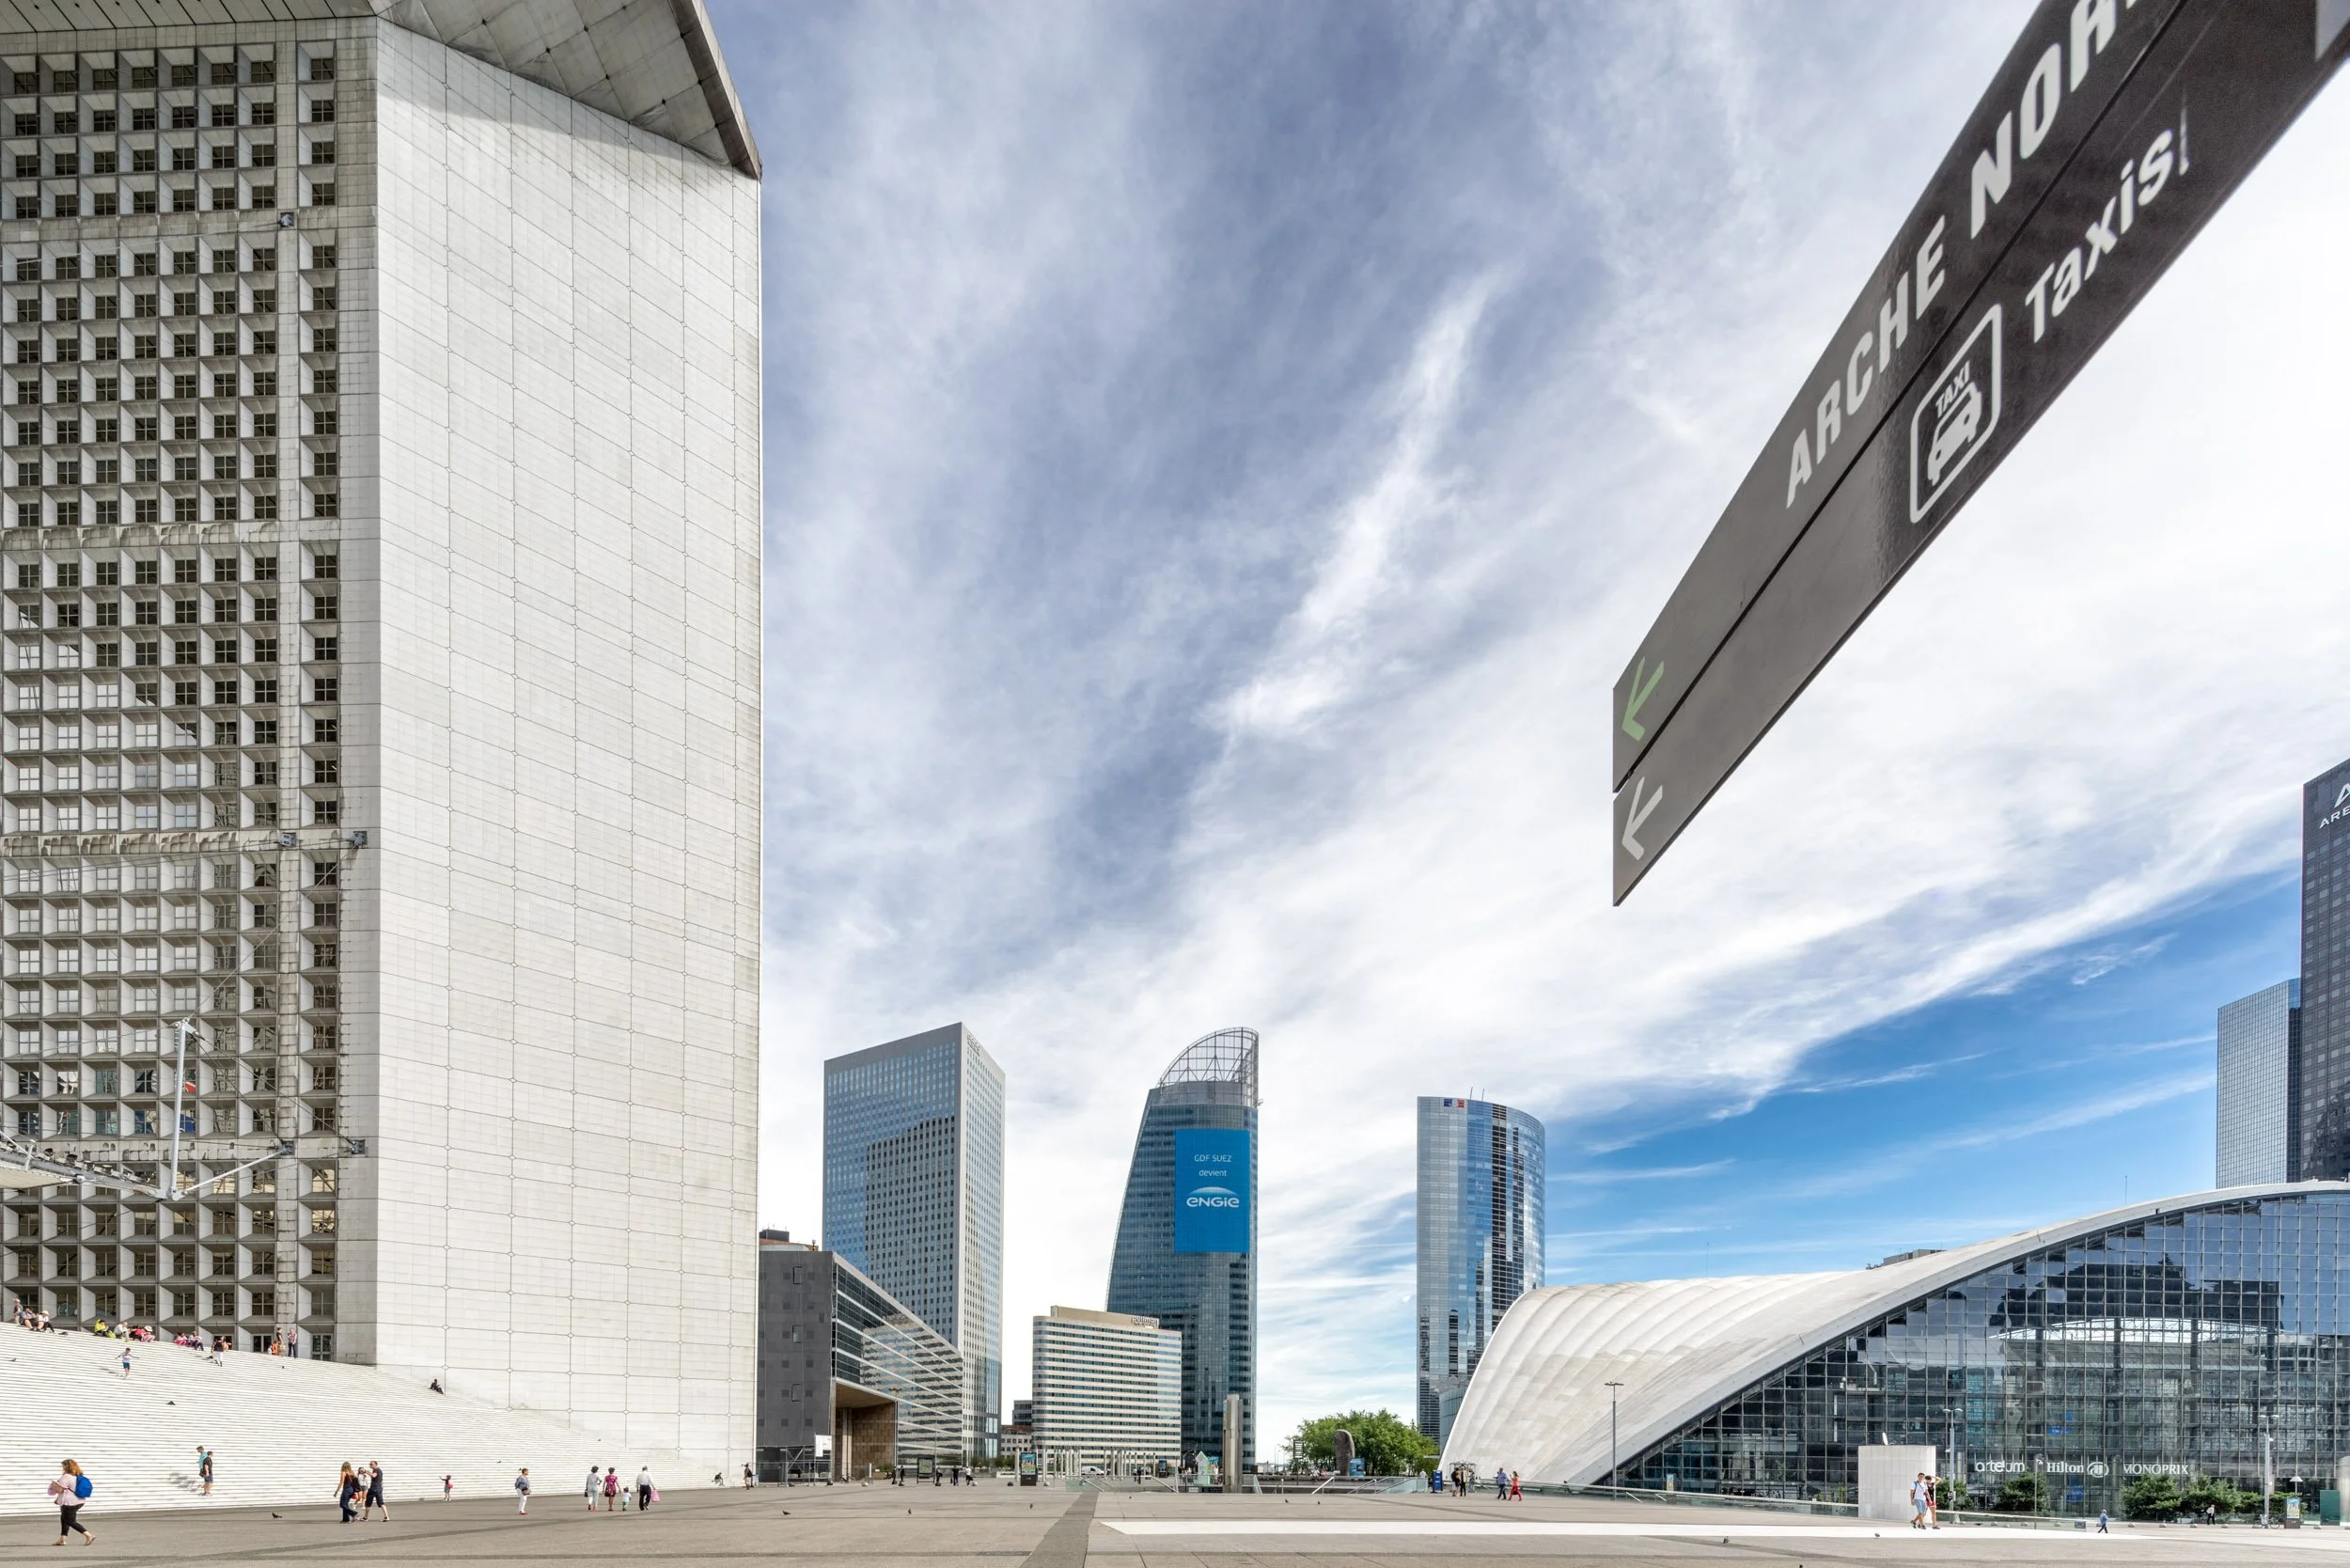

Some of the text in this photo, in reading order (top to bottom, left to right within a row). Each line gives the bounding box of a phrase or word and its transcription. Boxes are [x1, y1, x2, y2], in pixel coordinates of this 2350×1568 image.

[1787, 0, 2137, 509] ARCHE NOR
[2025, 129, 2172, 343] Taxis
[1935, 360, 1969, 418] TAXI
[1213, 1154, 1232, 1163] SUEZ
[2047, 1461, 2084, 1473] Hilton
[2123, 1463, 2188, 1475] MONOPRIX
